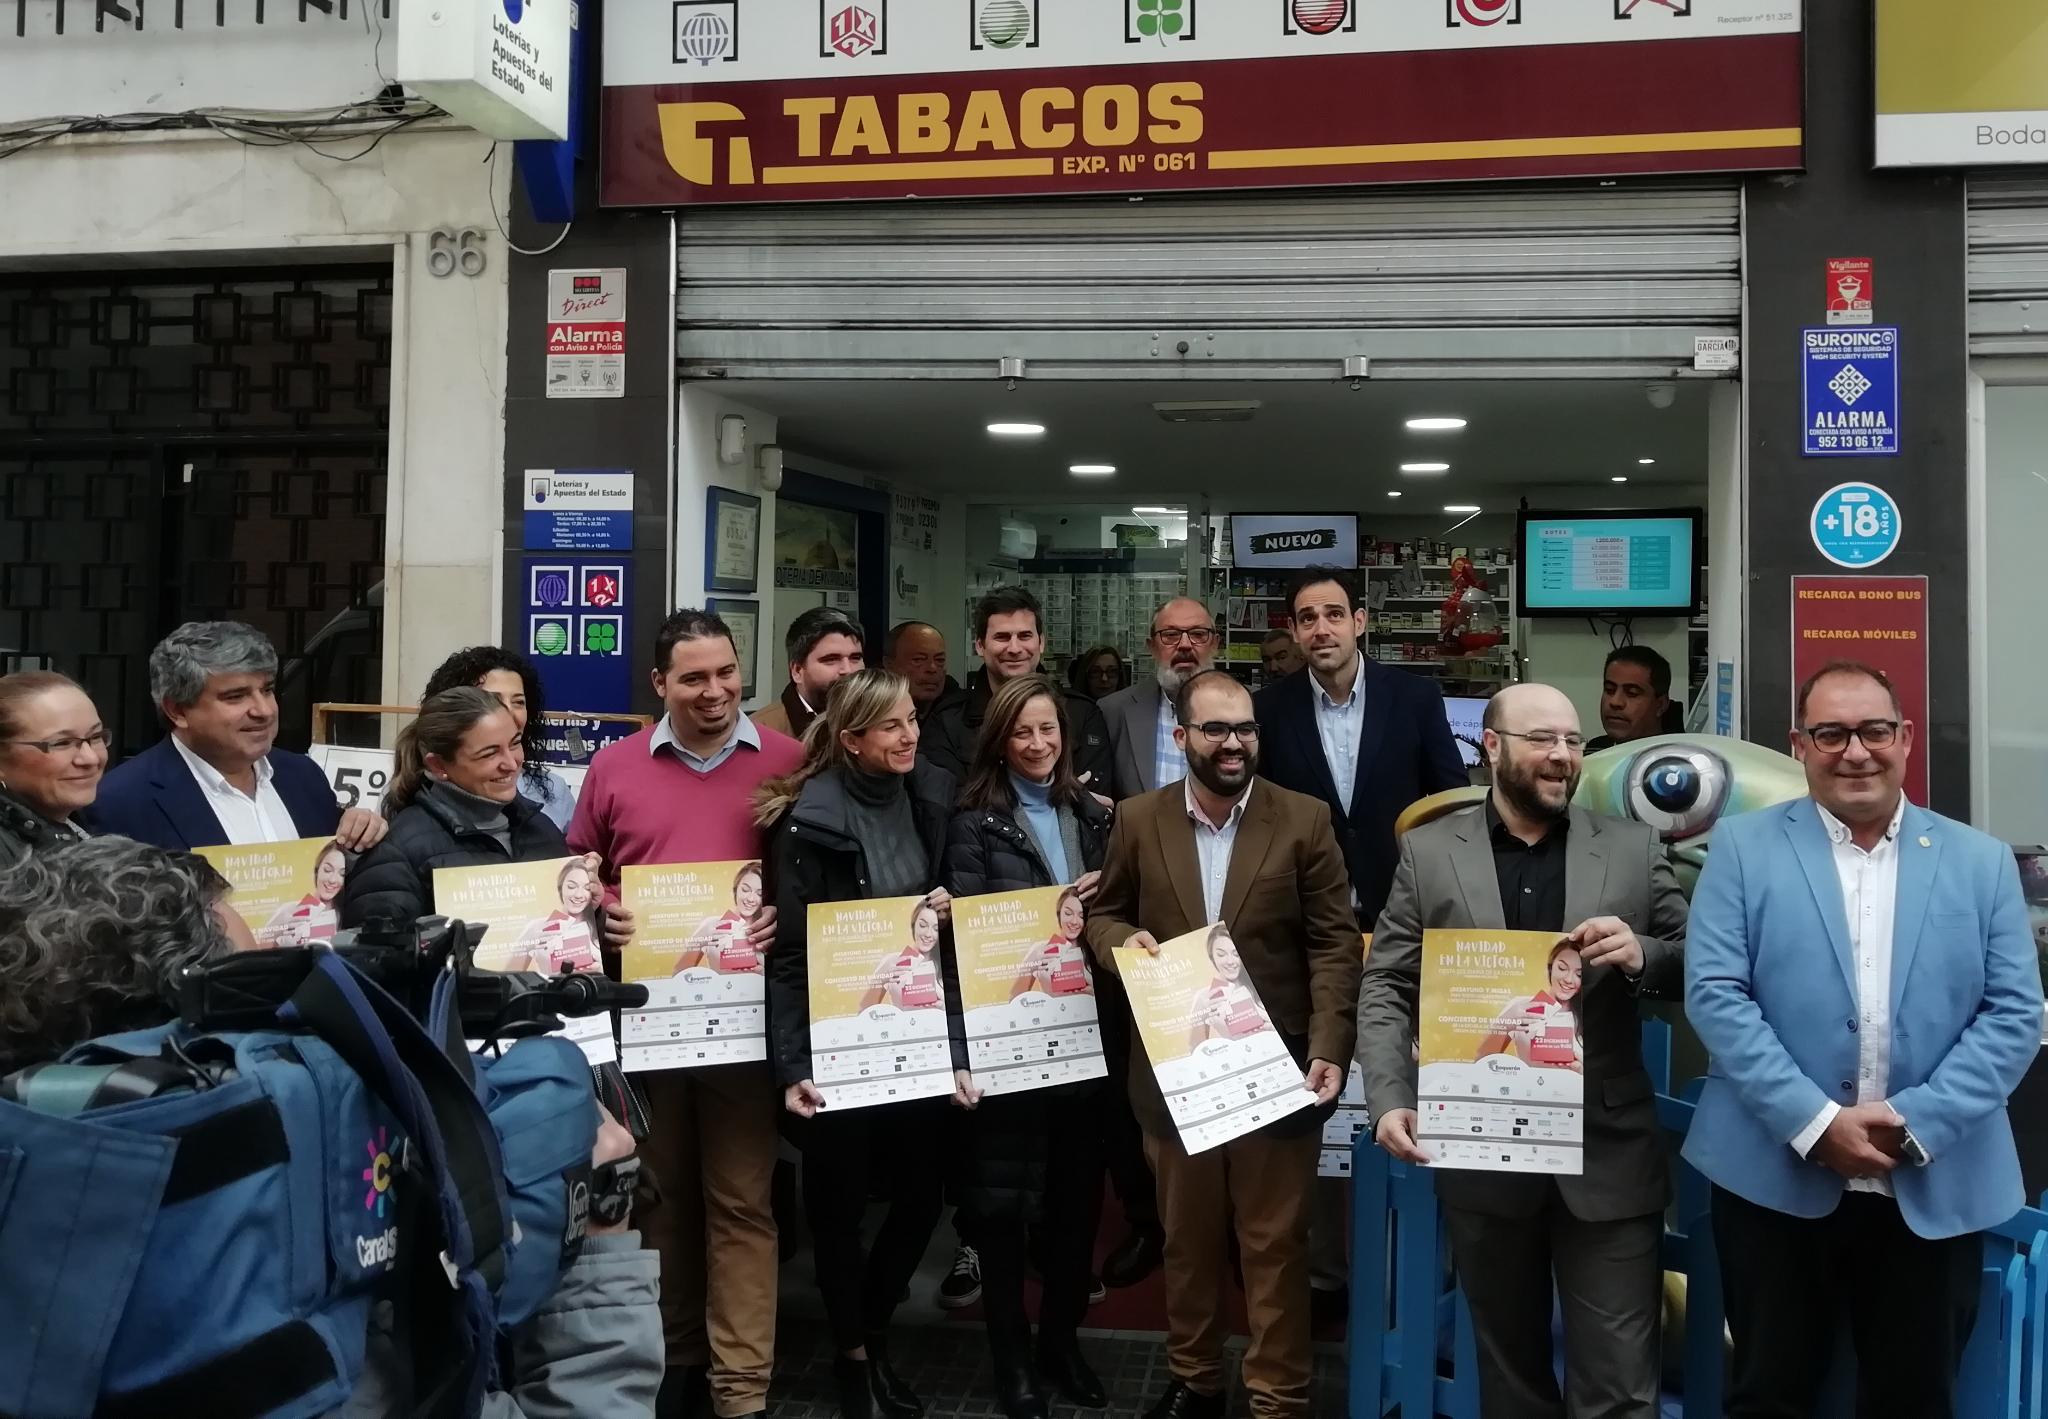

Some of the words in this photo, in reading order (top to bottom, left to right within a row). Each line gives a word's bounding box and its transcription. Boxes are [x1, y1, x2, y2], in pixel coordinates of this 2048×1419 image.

[1717, 16, 1753, 24] Receptor
[533, 47, 540, 64] y
[493, 38, 536, 80] Apuestas
[539, 71, 553, 92] del
[491, 59, 525, 94] Estado
[783, 81, 1204, 157] TABACOS
[1062, 156, 1110, 175] EXP.
[1153, 152, 1197, 171] 061
[426, 225, 487, 279] 66
[1829, 261, 1869, 270] Vigilante
[562, 293, 614, 316] Direct
[550, 326, 623, 343] Alarma
[566, 343, 588, 352] Aviso
[596, 343, 622, 351] Policía
[1815, 411, 1887, 428] ALARMA
[1818, 436, 1838, 448] 952
[1840, 436, 1852, 447] 13
[1855, 436, 1868, 447] 06
[1871, 436, 1884, 447] 12
[554, 490, 586, 498] Apuestas
[1823, 504, 1880, 537] +18
[1880, 506, 1889, 536] AÑOS
[1265, 533, 1322, 550] NUEVO
[1799, 590, 1856, 599] RECARGA
[1859, 590, 1894, 600] BONO
[1896, 590, 1922, 600] BUS
[1803, 630, 1860, 639] RECARGA
[1864, 628, 1917, 640] MÓVILES
[592, 720, 600, 731] y
[1450, 718, 1460, 727] de
[225, 853, 276, 868] NAVIDAD
[652, 872, 698, 884] NAVIDAD
[670, 884, 714, 897] VICTORIA
[980, 900, 1022, 914] NAVIDAD
[836, 909, 878, 922] NAVIDAD
[996, 910, 1039, 924] VICTORIA
[852, 920, 894, 934] VICTORIA
[1456, 940, 1506, 953] NAVIDAD
[1456, 954, 1470, 967] LA
[1474, 954, 1525, 969] VICTORIA
